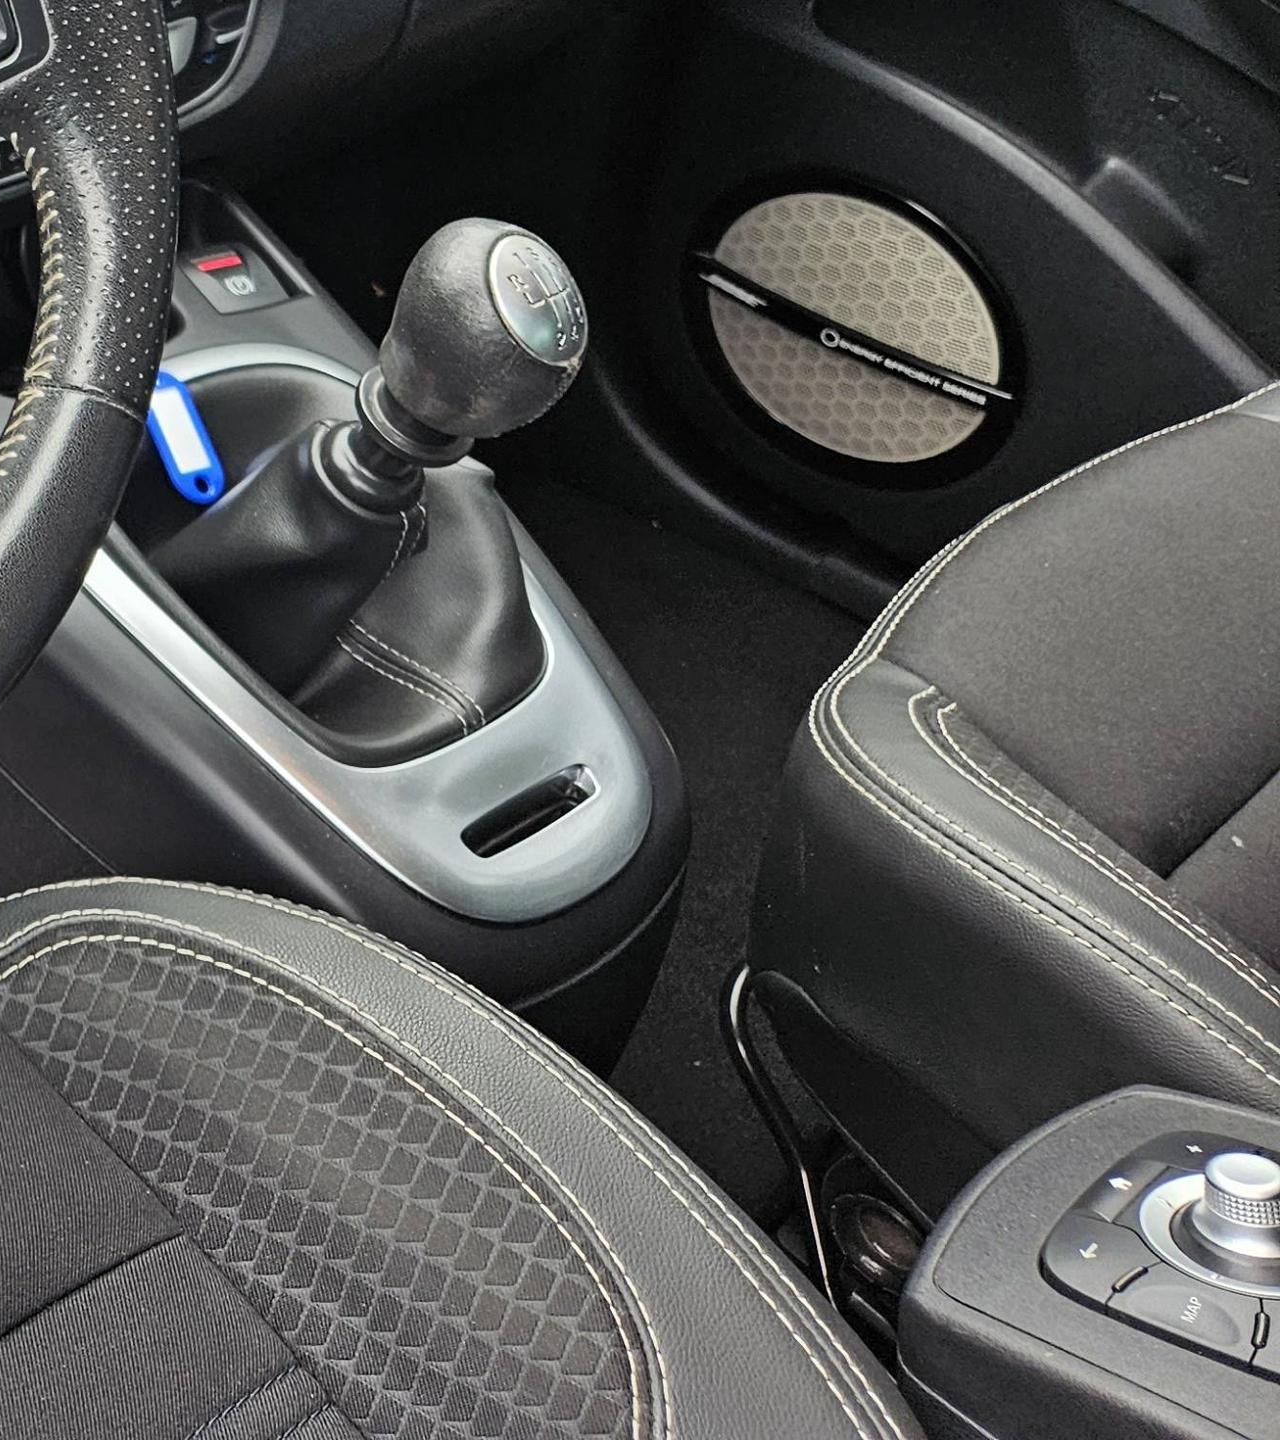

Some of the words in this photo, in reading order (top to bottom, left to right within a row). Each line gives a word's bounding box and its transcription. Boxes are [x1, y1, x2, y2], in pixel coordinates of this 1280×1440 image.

[506, 273, 529, 292] R
[556, 331, 568, 351] 2
[1179, 1296, 1203, 1324] MAP
